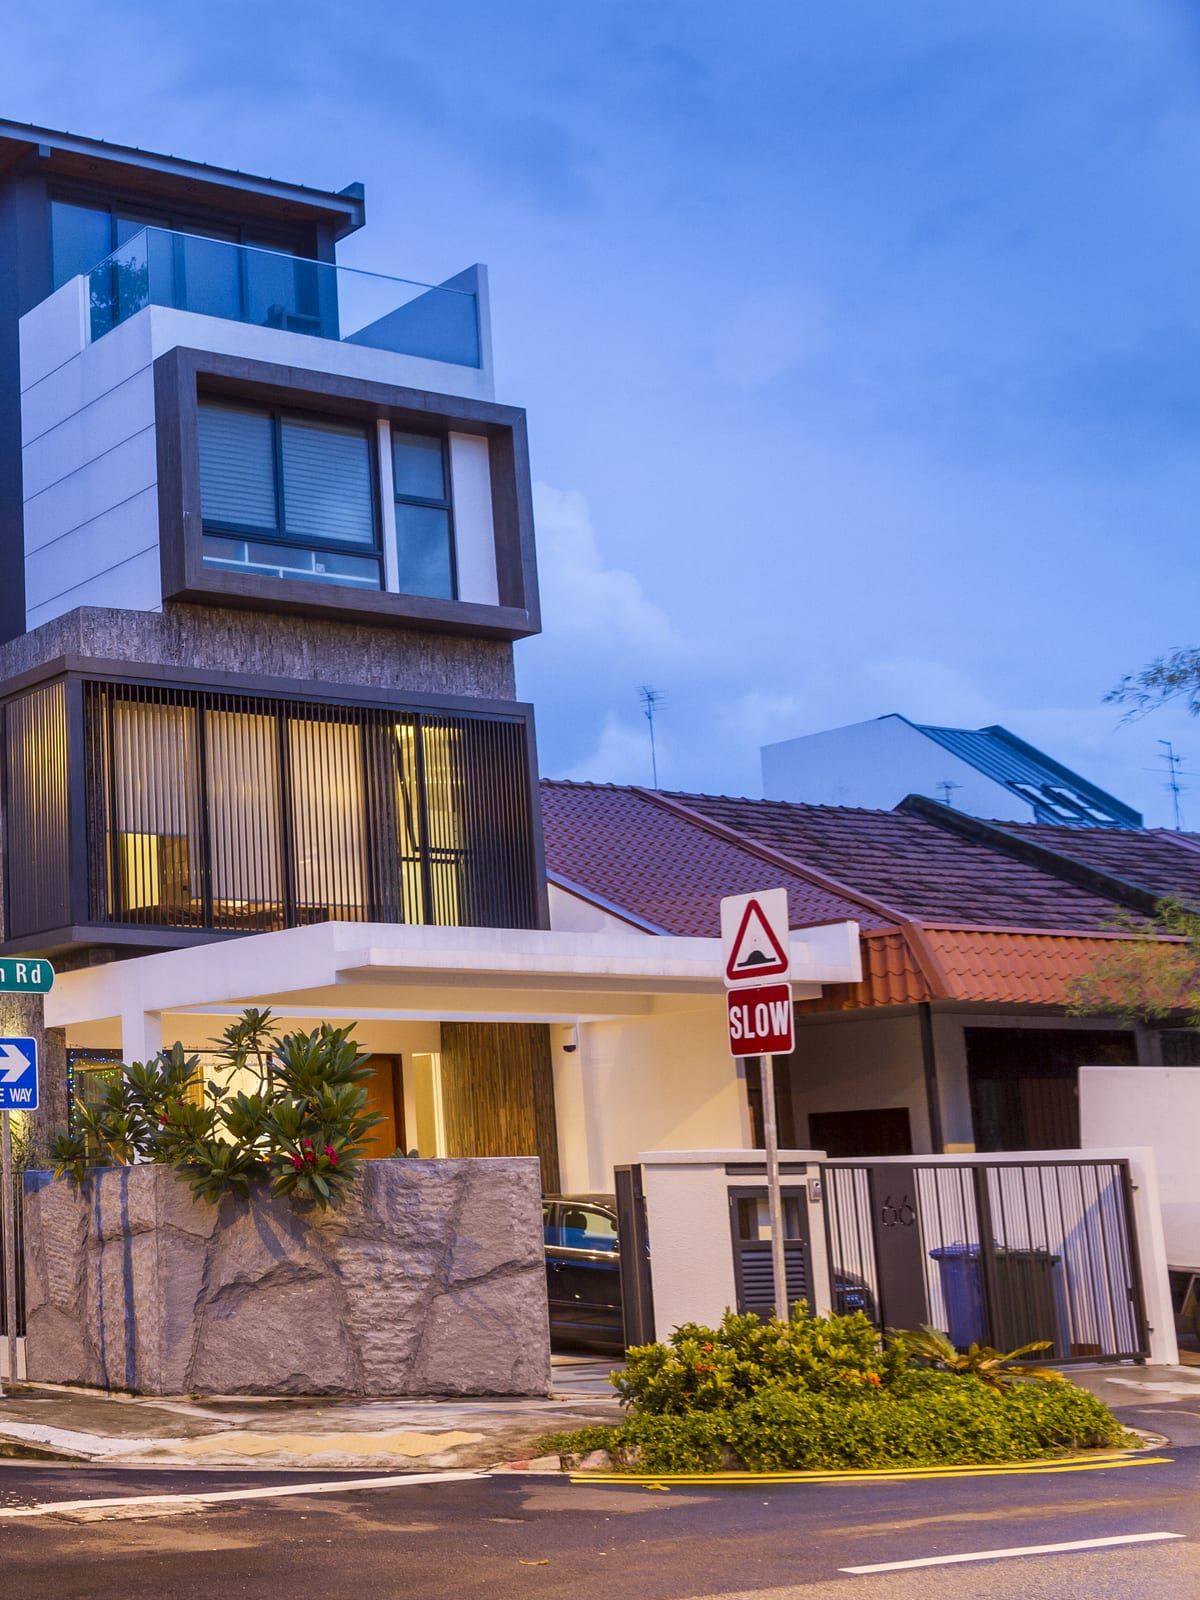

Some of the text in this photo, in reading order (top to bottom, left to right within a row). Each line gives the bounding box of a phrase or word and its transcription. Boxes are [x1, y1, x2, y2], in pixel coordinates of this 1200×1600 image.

[15, 963, 42, 984] Rd
[729, 1000, 790, 1040] SLOW
[9, 1087, 32, 1102] WAY
[882, 1195, 916, 1227] 66
